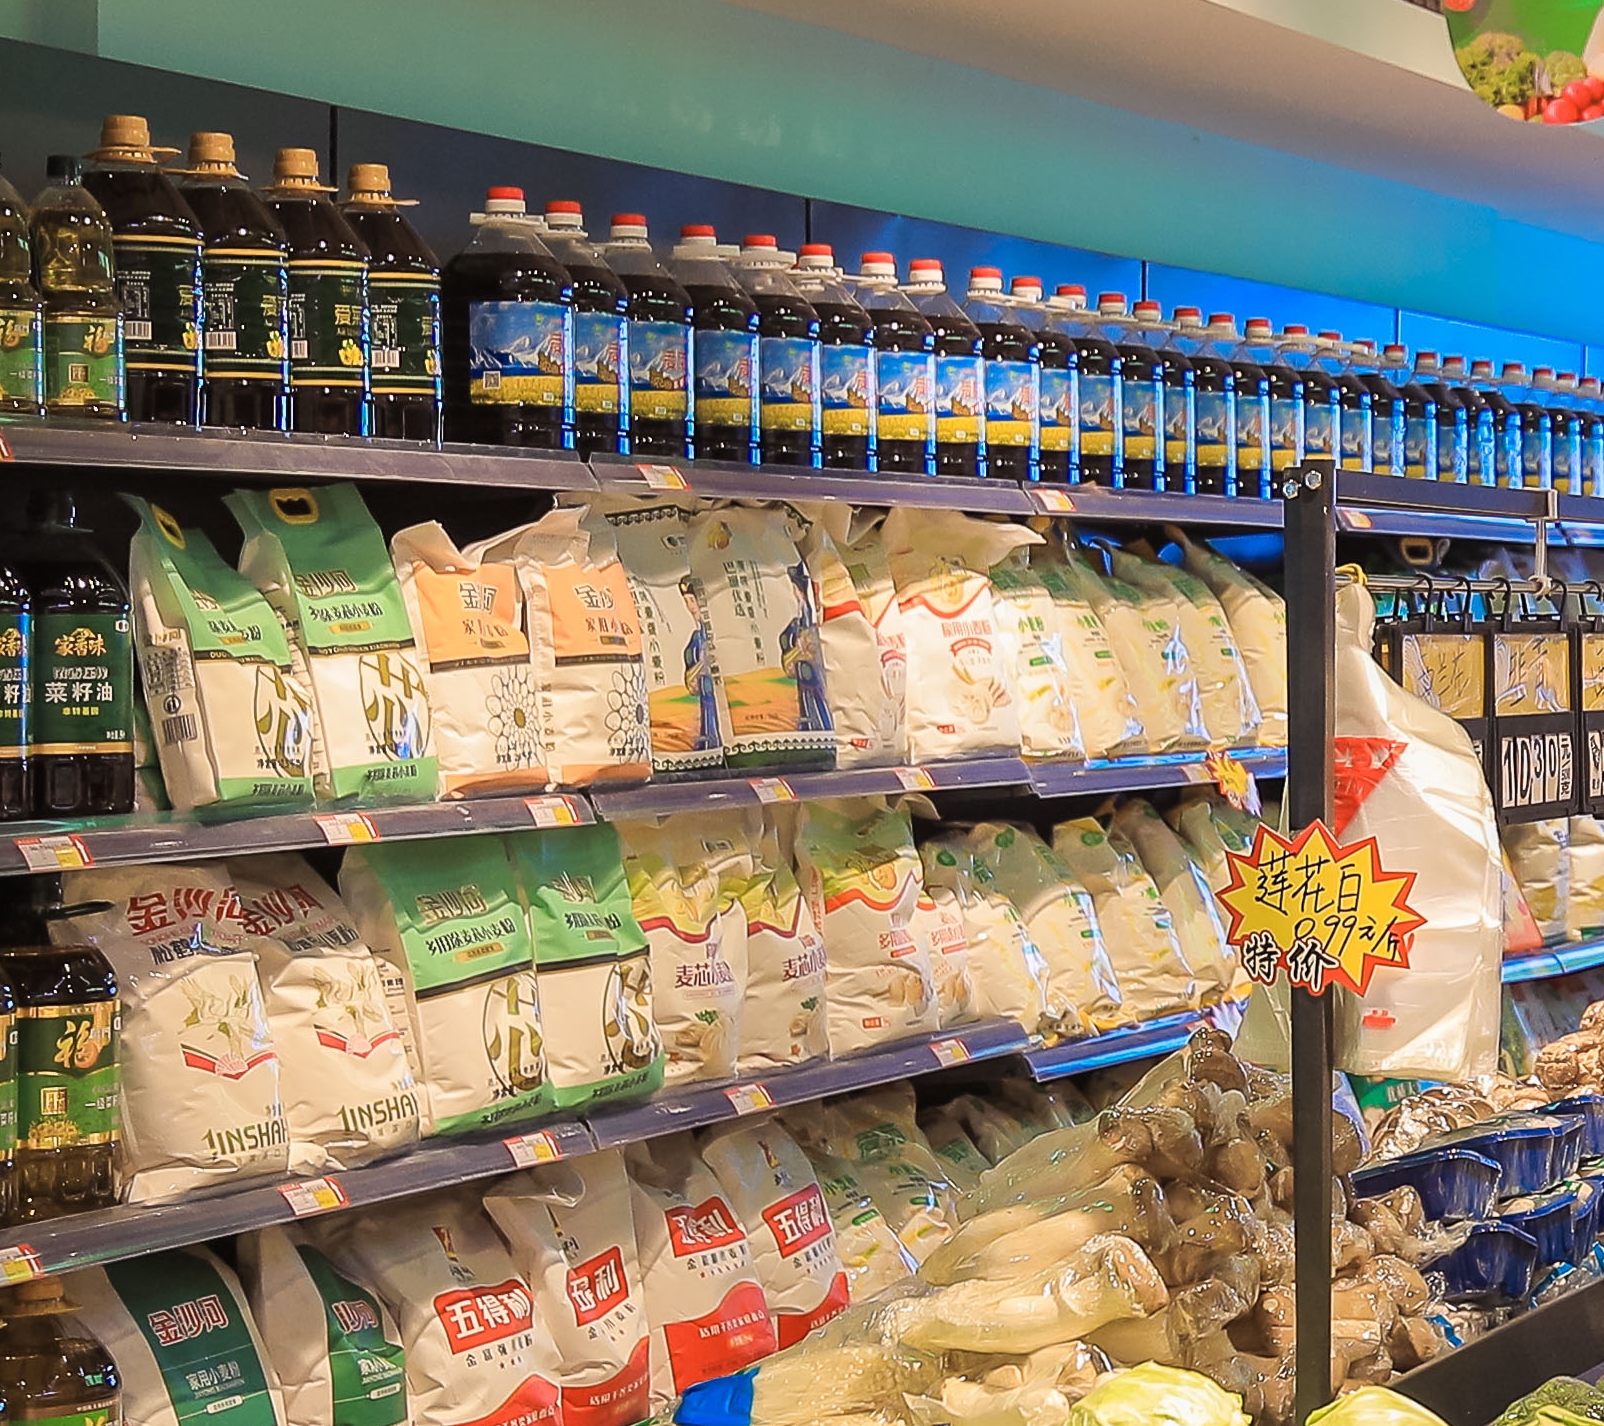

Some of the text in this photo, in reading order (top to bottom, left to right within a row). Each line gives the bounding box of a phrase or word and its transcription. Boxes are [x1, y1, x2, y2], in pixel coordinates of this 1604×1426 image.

[54, 627, 107, 658] 家香味
[44, 681, 113, 704] 菜籽油
[1255, 851, 1362, 915] 莲花白
[1245, 935, 1338, 991] 特价
[449, 1290, 532, 1339] 五得利
